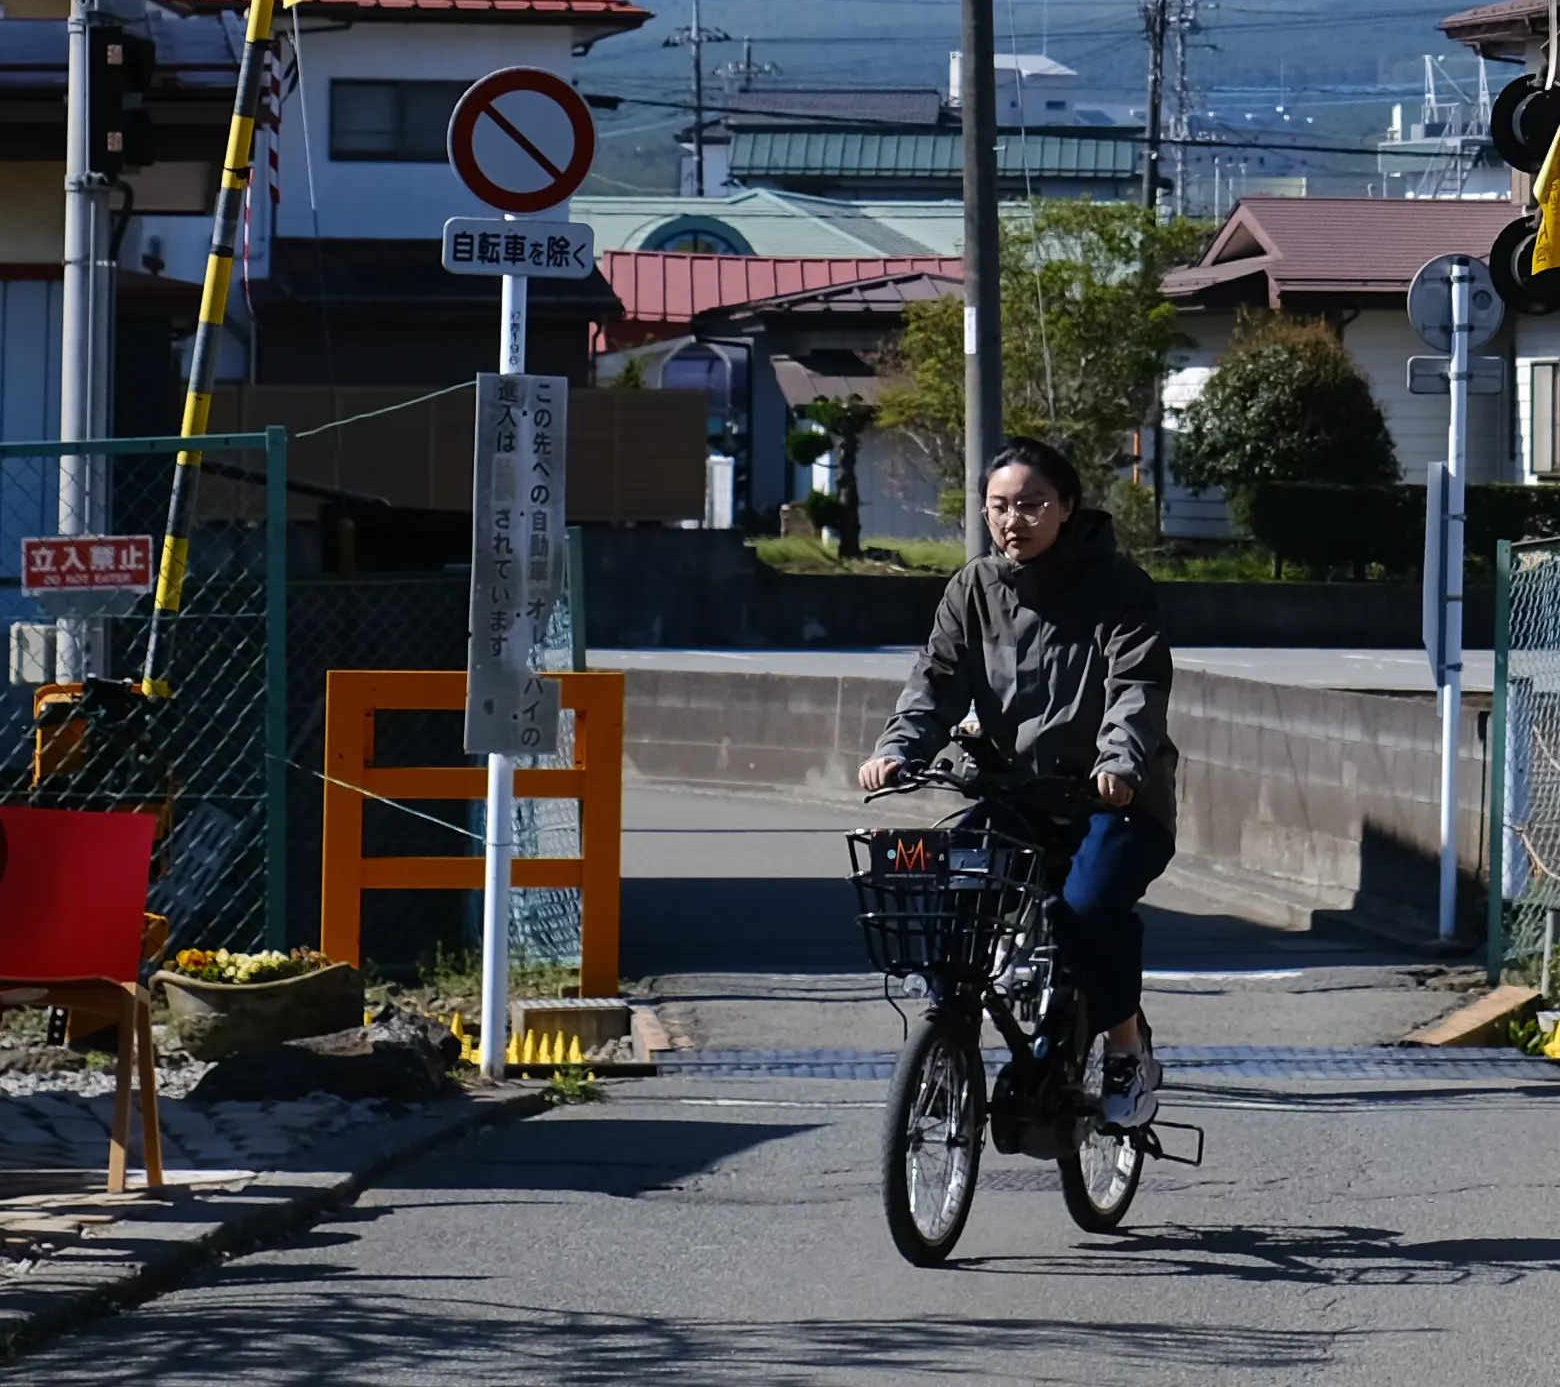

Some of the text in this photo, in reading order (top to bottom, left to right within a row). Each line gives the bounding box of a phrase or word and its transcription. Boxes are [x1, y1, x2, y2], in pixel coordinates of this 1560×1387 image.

[452, 230, 587, 269] 自転車を除く
[30, 545, 145, 572] 立入禁止
